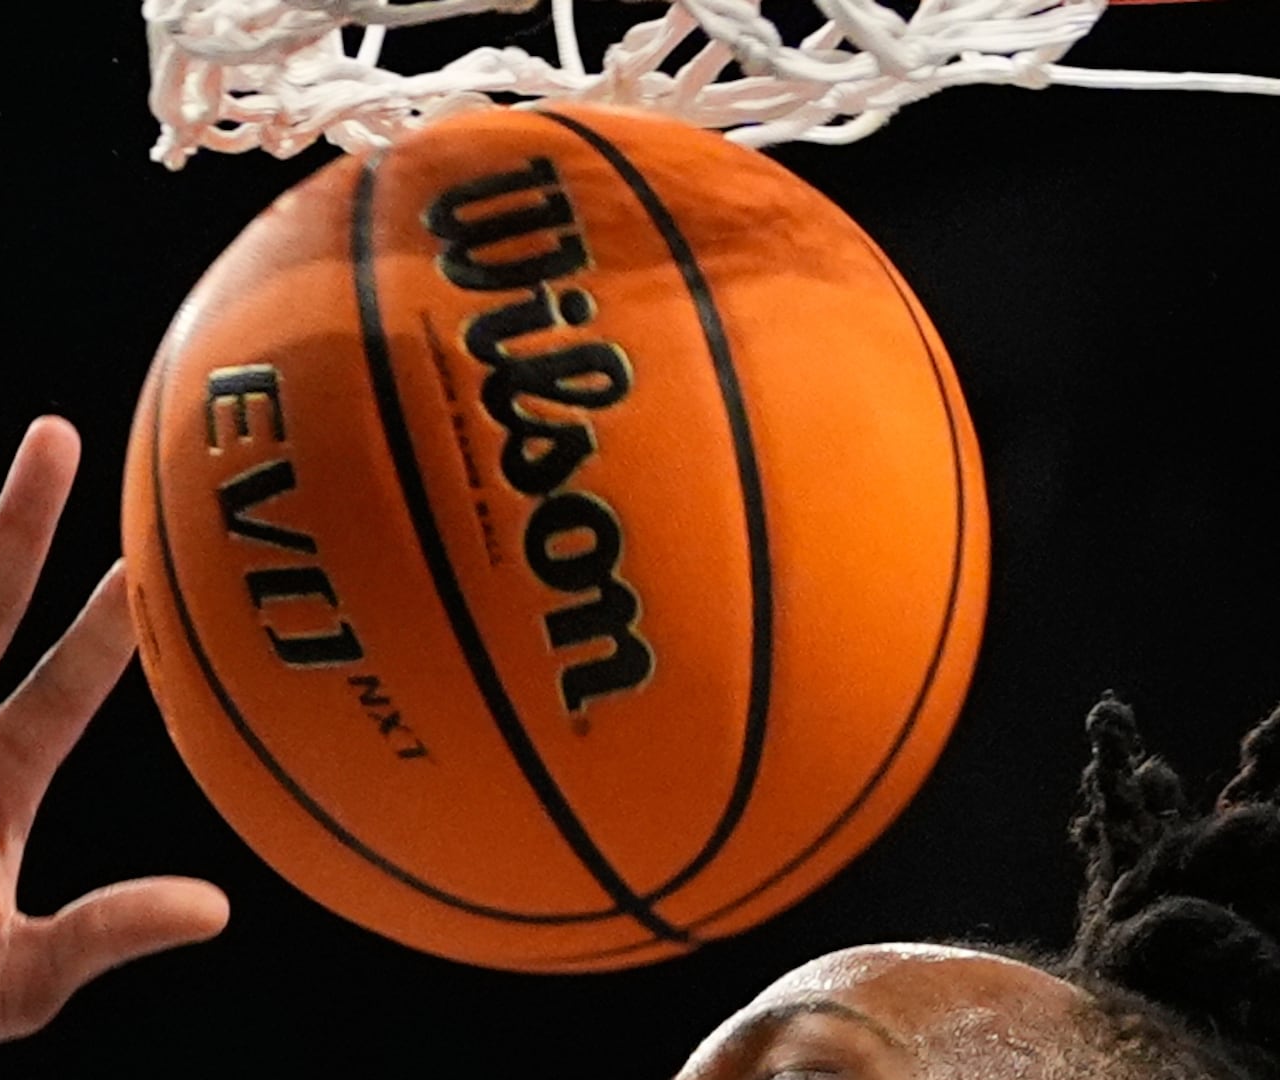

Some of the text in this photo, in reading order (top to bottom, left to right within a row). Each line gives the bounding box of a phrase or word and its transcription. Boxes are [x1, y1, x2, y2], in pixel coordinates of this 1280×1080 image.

[204, 361, 437, 766] EVO NXT
[420, 154, 657, 715] Wilson
